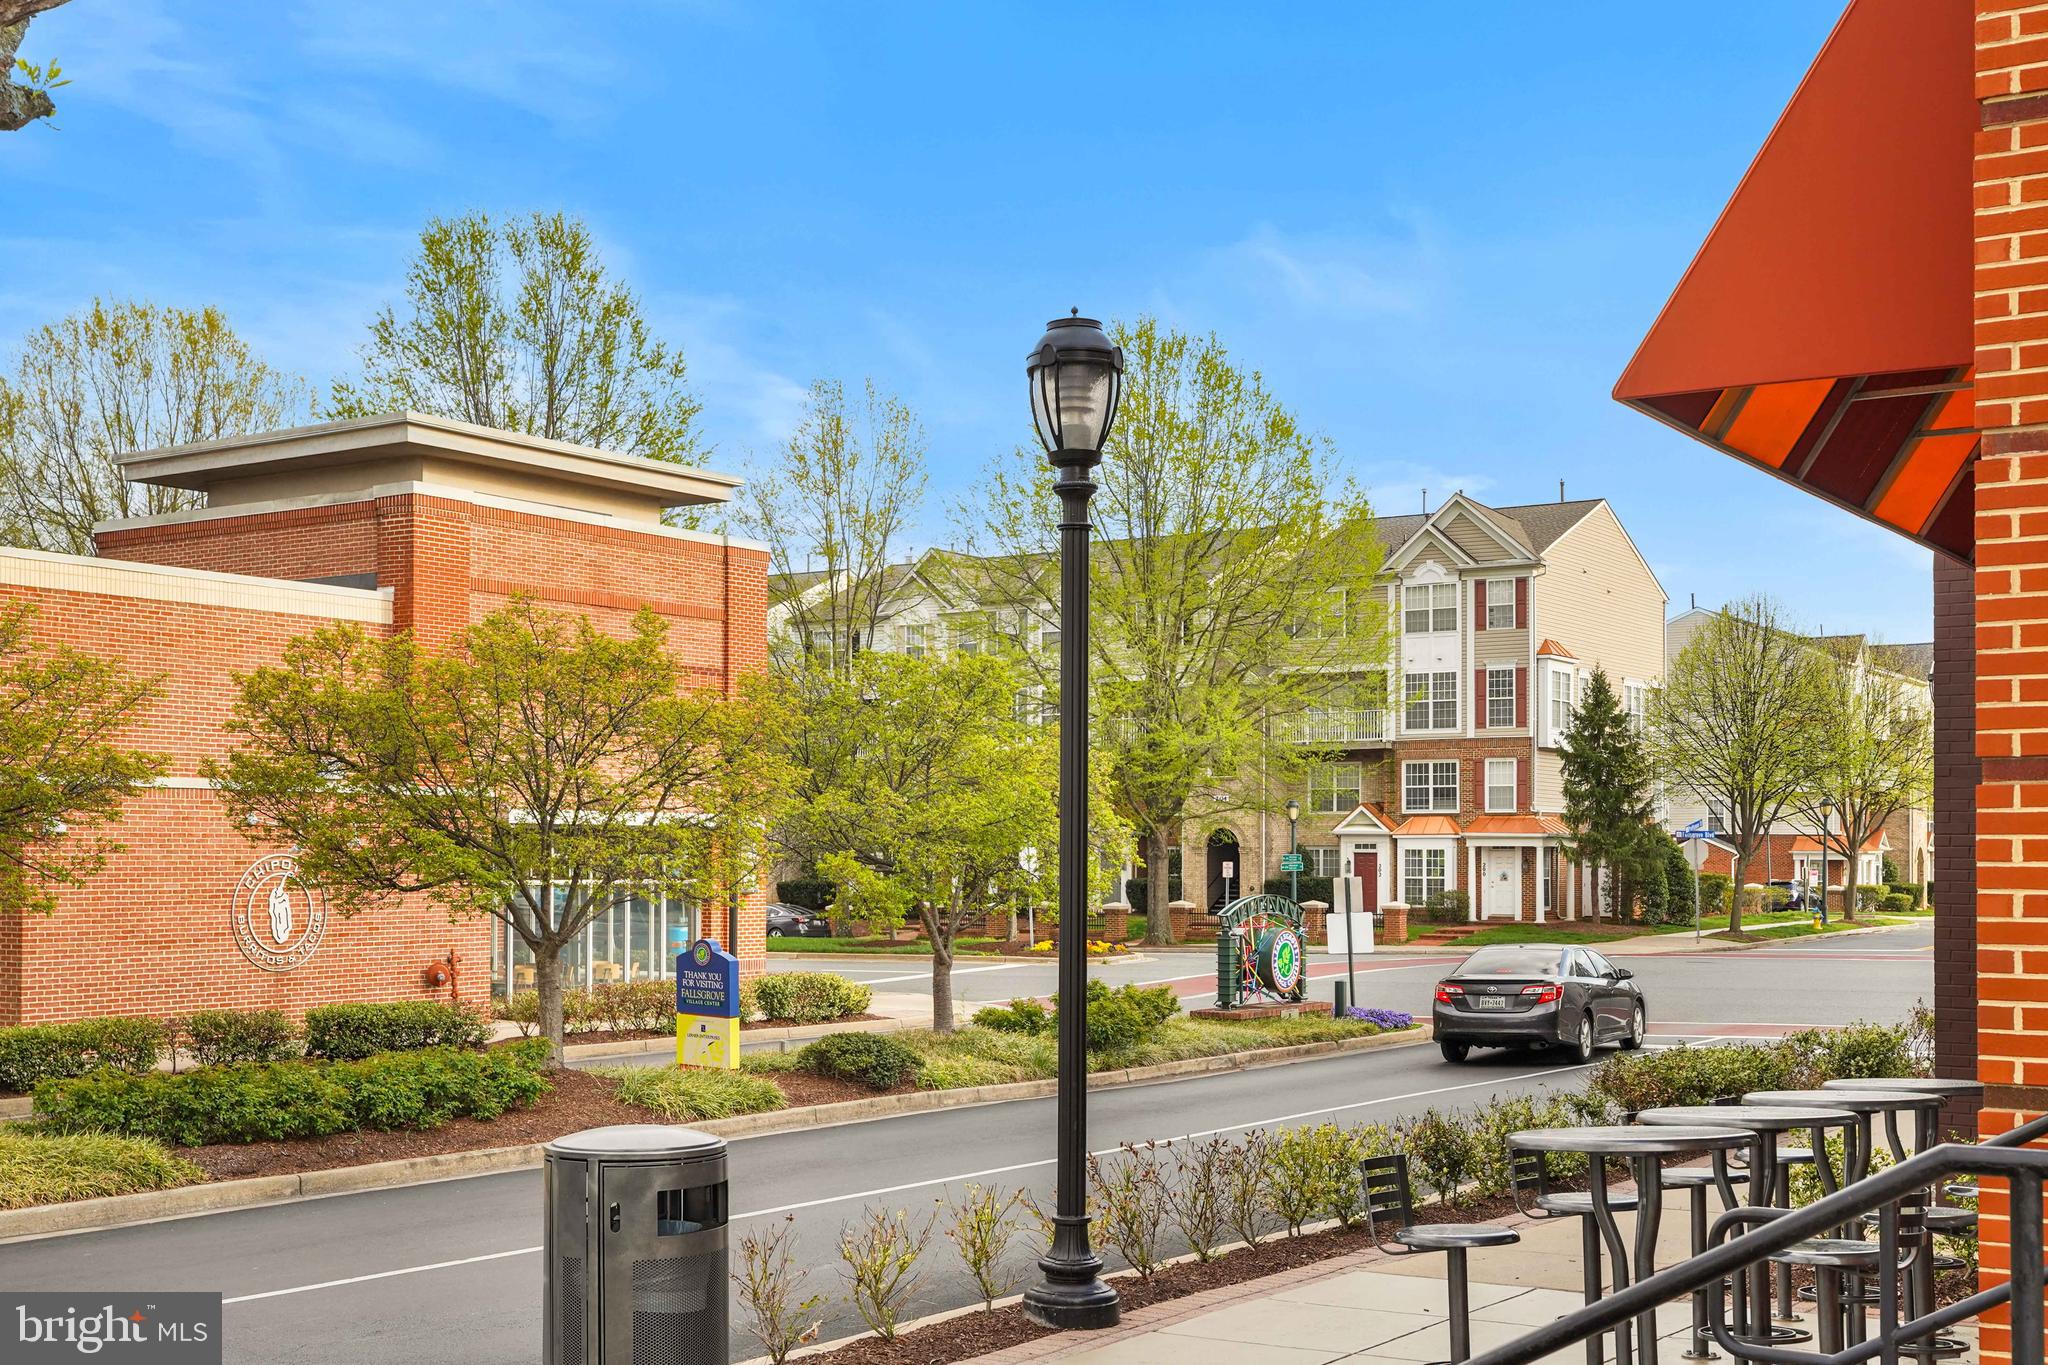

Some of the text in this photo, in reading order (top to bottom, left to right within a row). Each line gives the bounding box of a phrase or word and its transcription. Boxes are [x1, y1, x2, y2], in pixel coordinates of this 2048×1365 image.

[237, 912, 321, 964] BURRITOS & TACOS
[683, 970, 722, 981] THANK YOU
[682, 978, 724, 990] FOR VISITING
[681, 988, 725, 1001] FALLSGROVE
